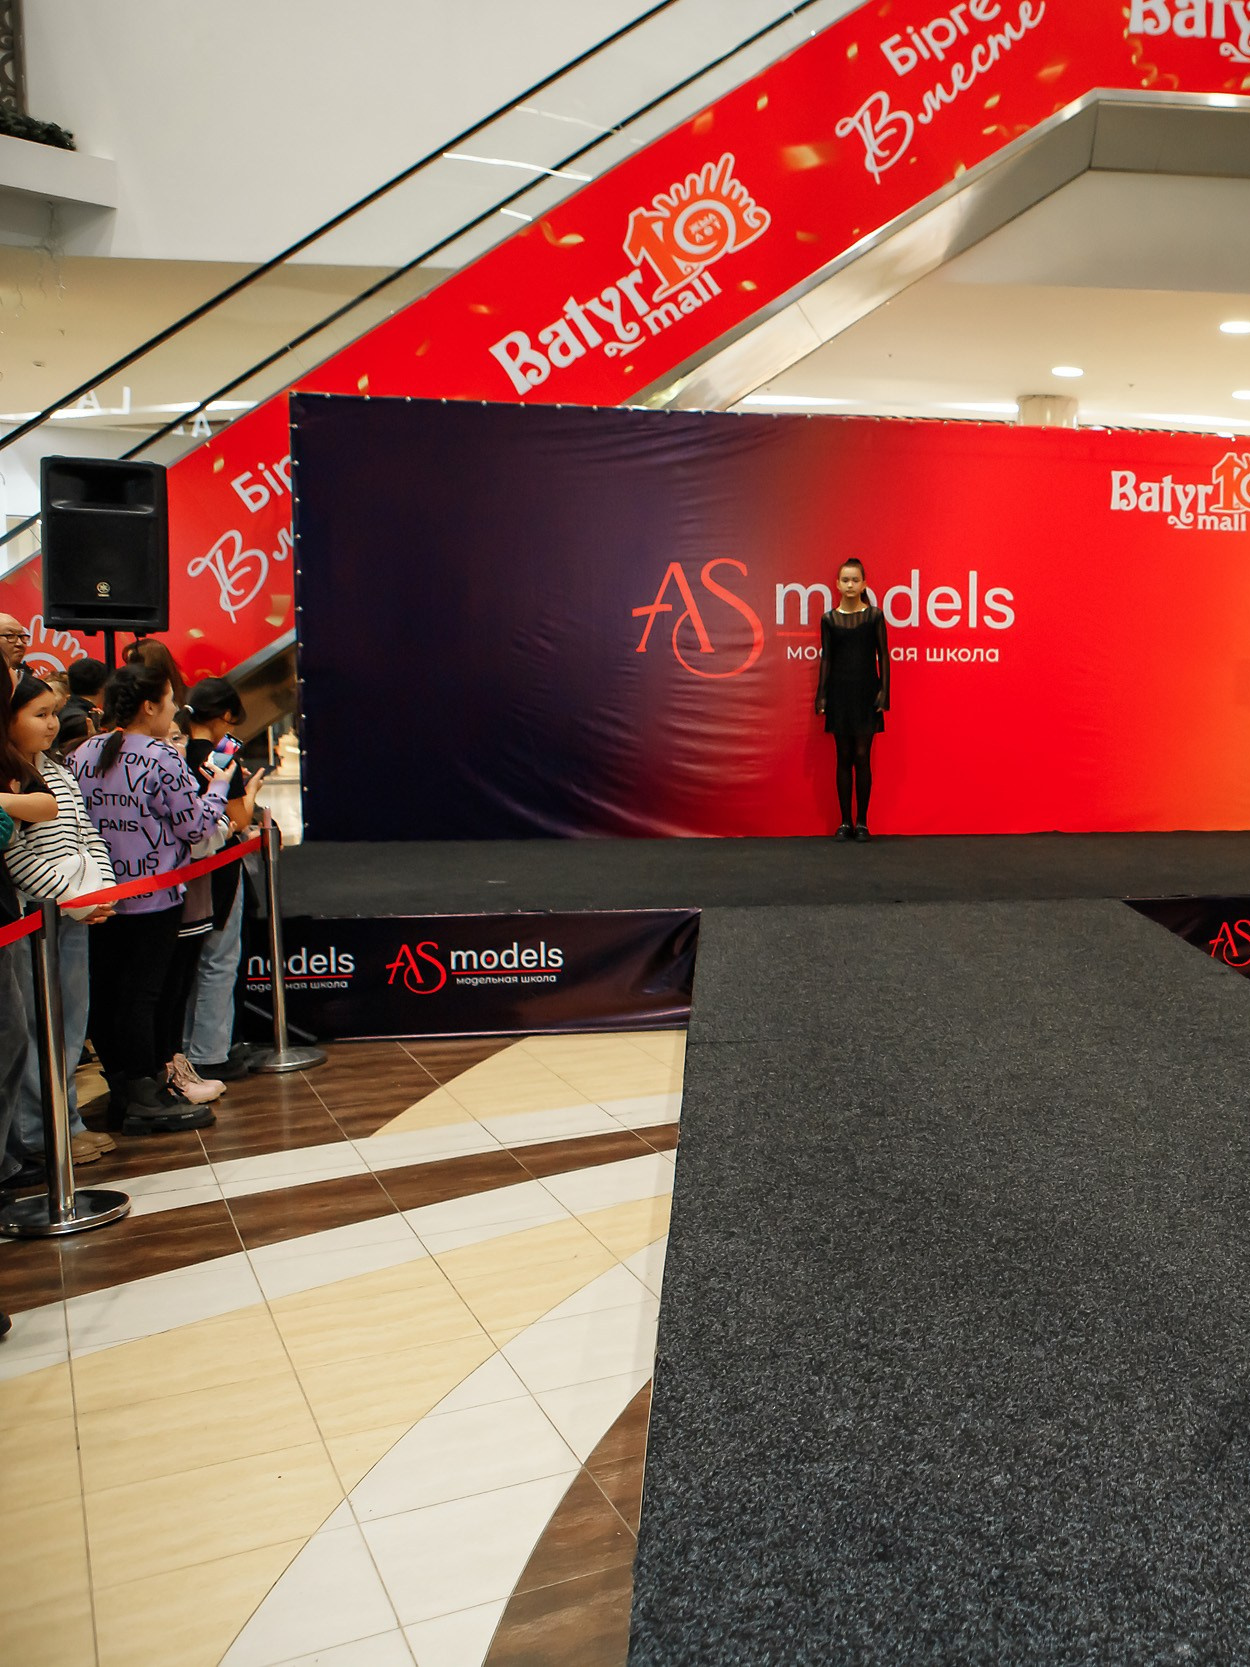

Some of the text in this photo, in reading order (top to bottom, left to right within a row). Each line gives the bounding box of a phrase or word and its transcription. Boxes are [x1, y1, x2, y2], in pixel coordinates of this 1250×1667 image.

[880, 0, 1001, 76] Бірге
[835, 1, 1046, 184] Вместе
[488, 268, 650, 396] Batyr
[642, 271, 722, 335] mall
[1110, 470, 1214, 529] Batyr
[1197, 513, 1247, 531] mall
[632, 558, 1015, 679] AS mdels
[926, 647, 999, 662] школа
[310, 979, 348, 989] школа
[386, 941, 564, 995] AS models
[456, 973, 557, 987] модельная школа
